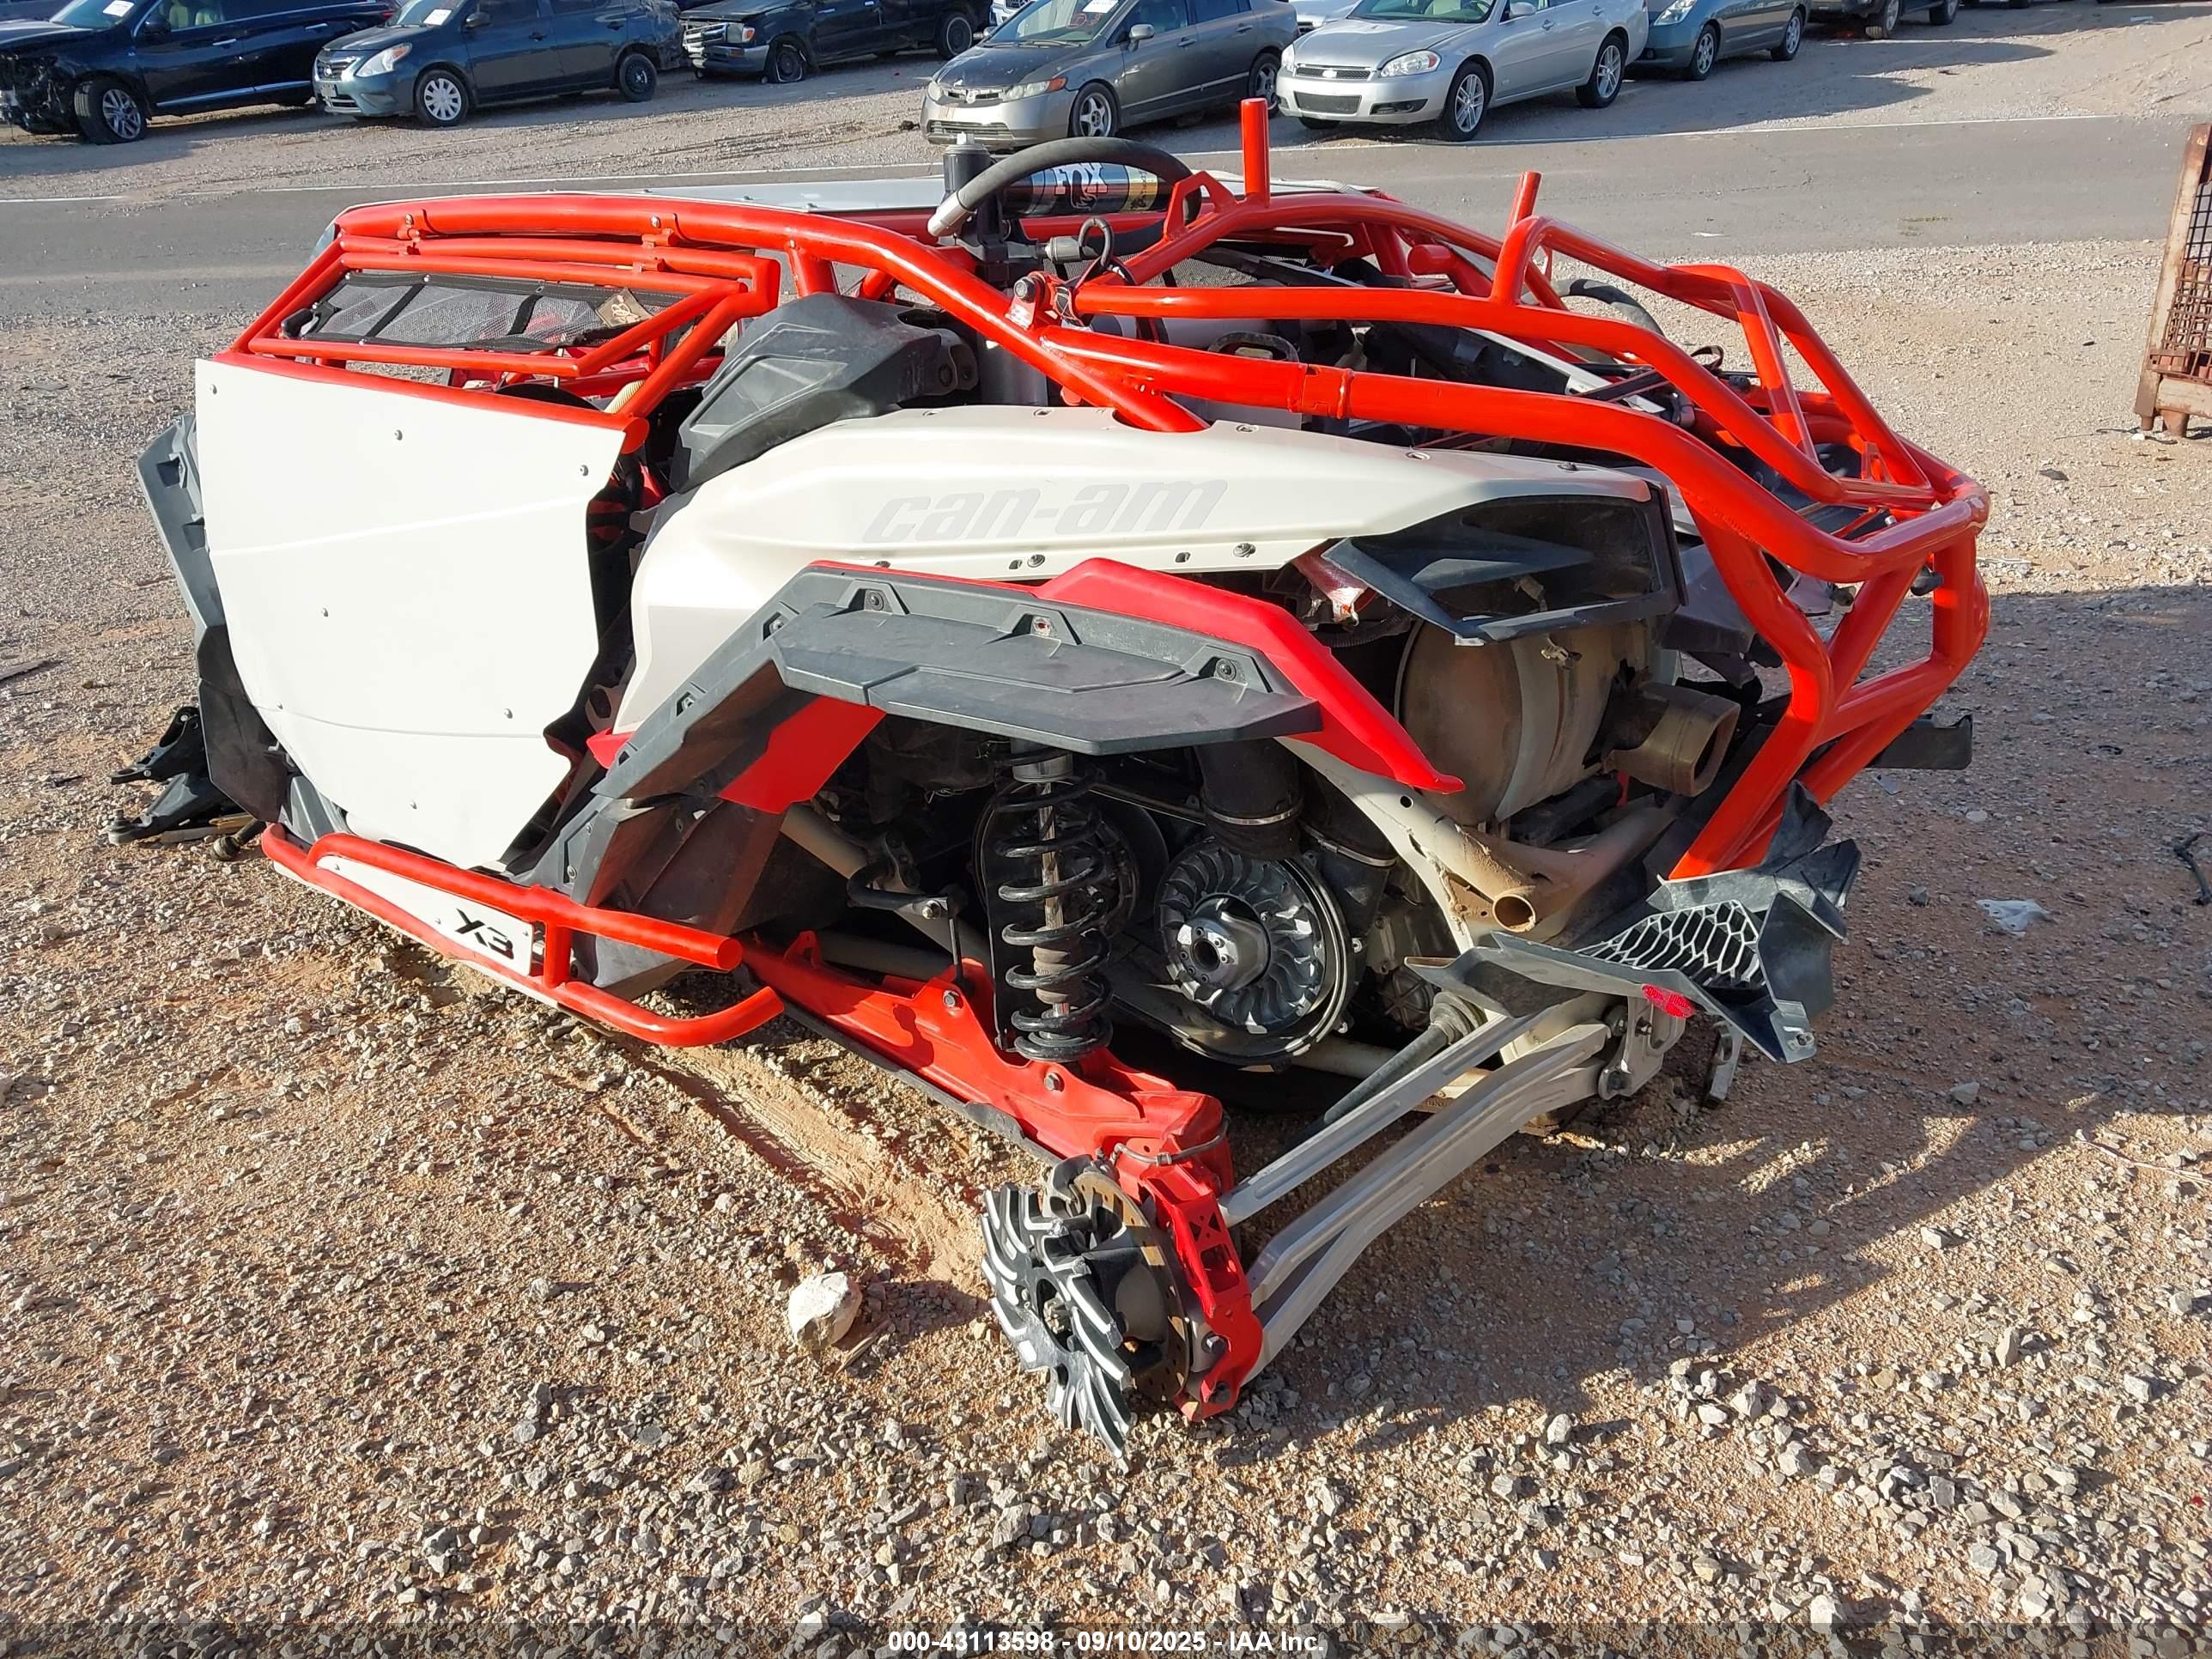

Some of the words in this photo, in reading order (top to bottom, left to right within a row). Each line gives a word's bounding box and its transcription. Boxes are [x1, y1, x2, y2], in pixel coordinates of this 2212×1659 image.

[1051, 162, 1108, 206] FOX
[861, 479, 1229, 544] can-am
[454, 908, 514, 960] X3
